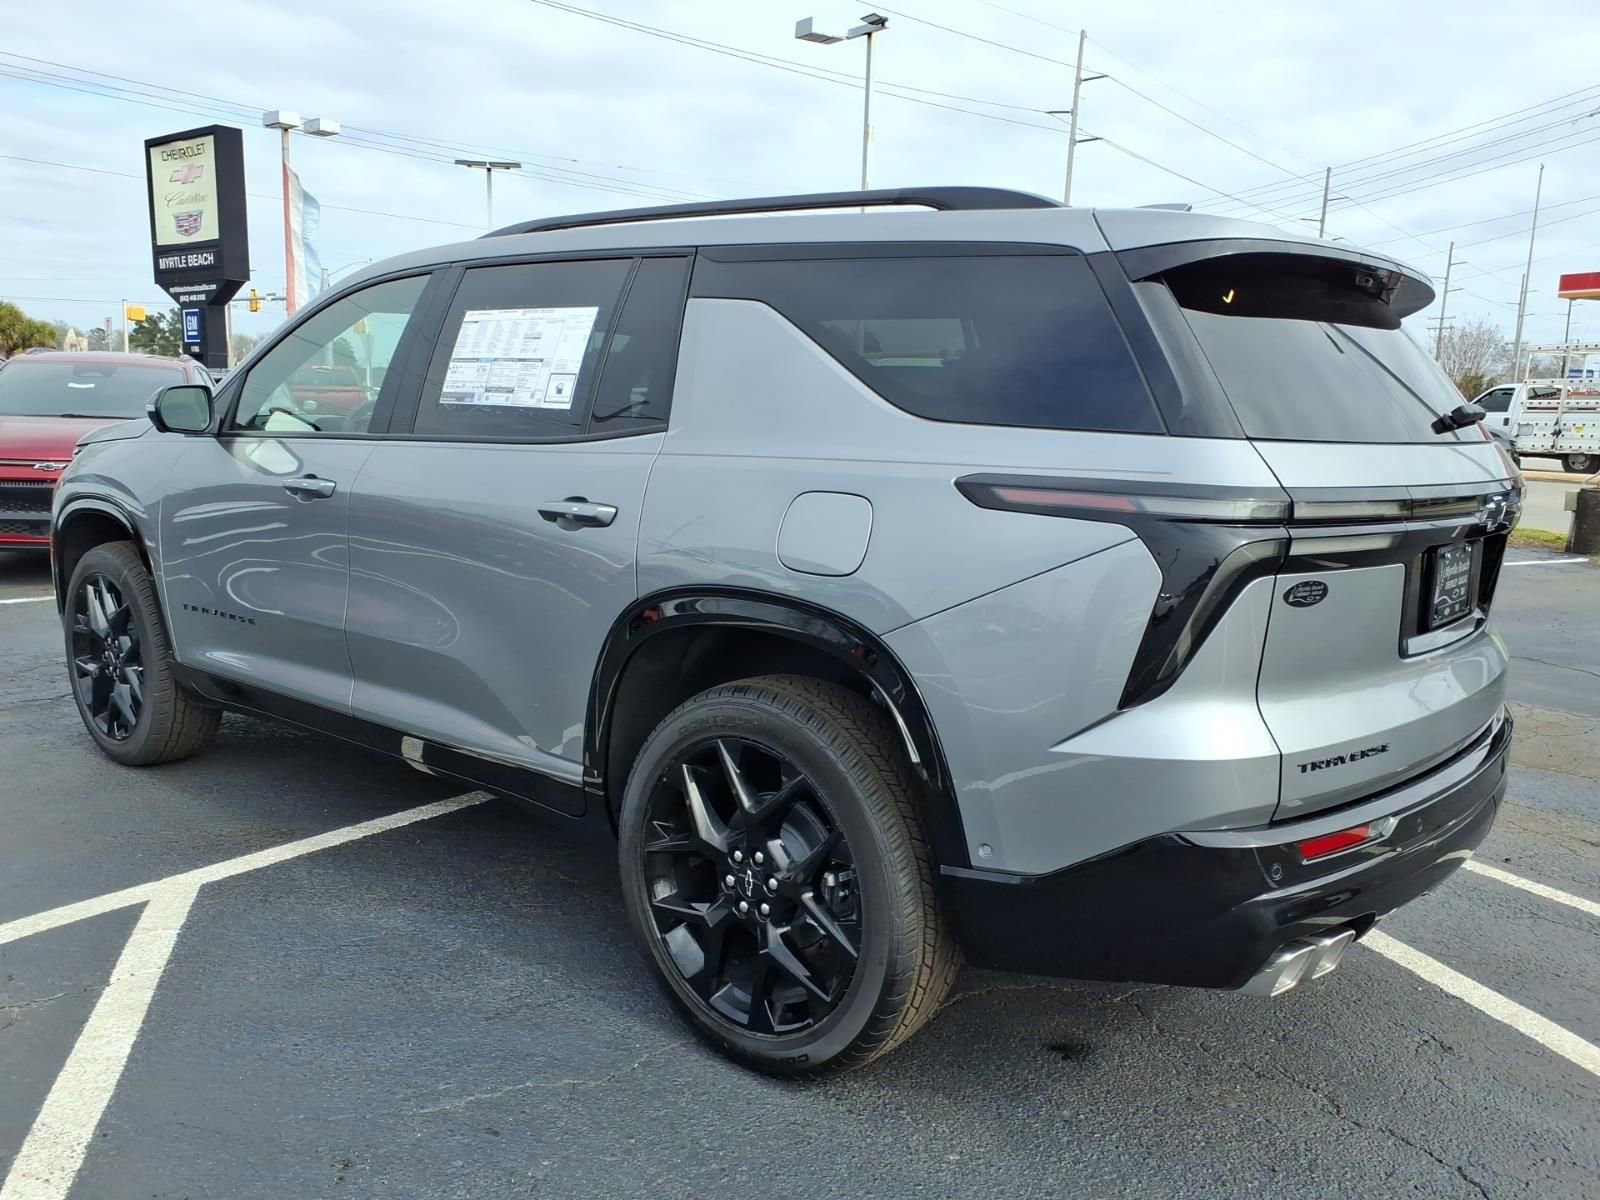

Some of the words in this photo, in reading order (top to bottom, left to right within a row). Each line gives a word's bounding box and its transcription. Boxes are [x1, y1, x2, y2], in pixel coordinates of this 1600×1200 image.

[161, 143, 206, 161] CHEVROLET
[164, 190, 209, 208] Cadillac
[160, 256, 187, 269] MYRTLE
[188, 252, 214, 266] BEACH
[187, 315, 198, 330] GM
[182, 603, 256, 625] TRAVERSE
[1297, 742, 1391, 774] TRAVERSE
